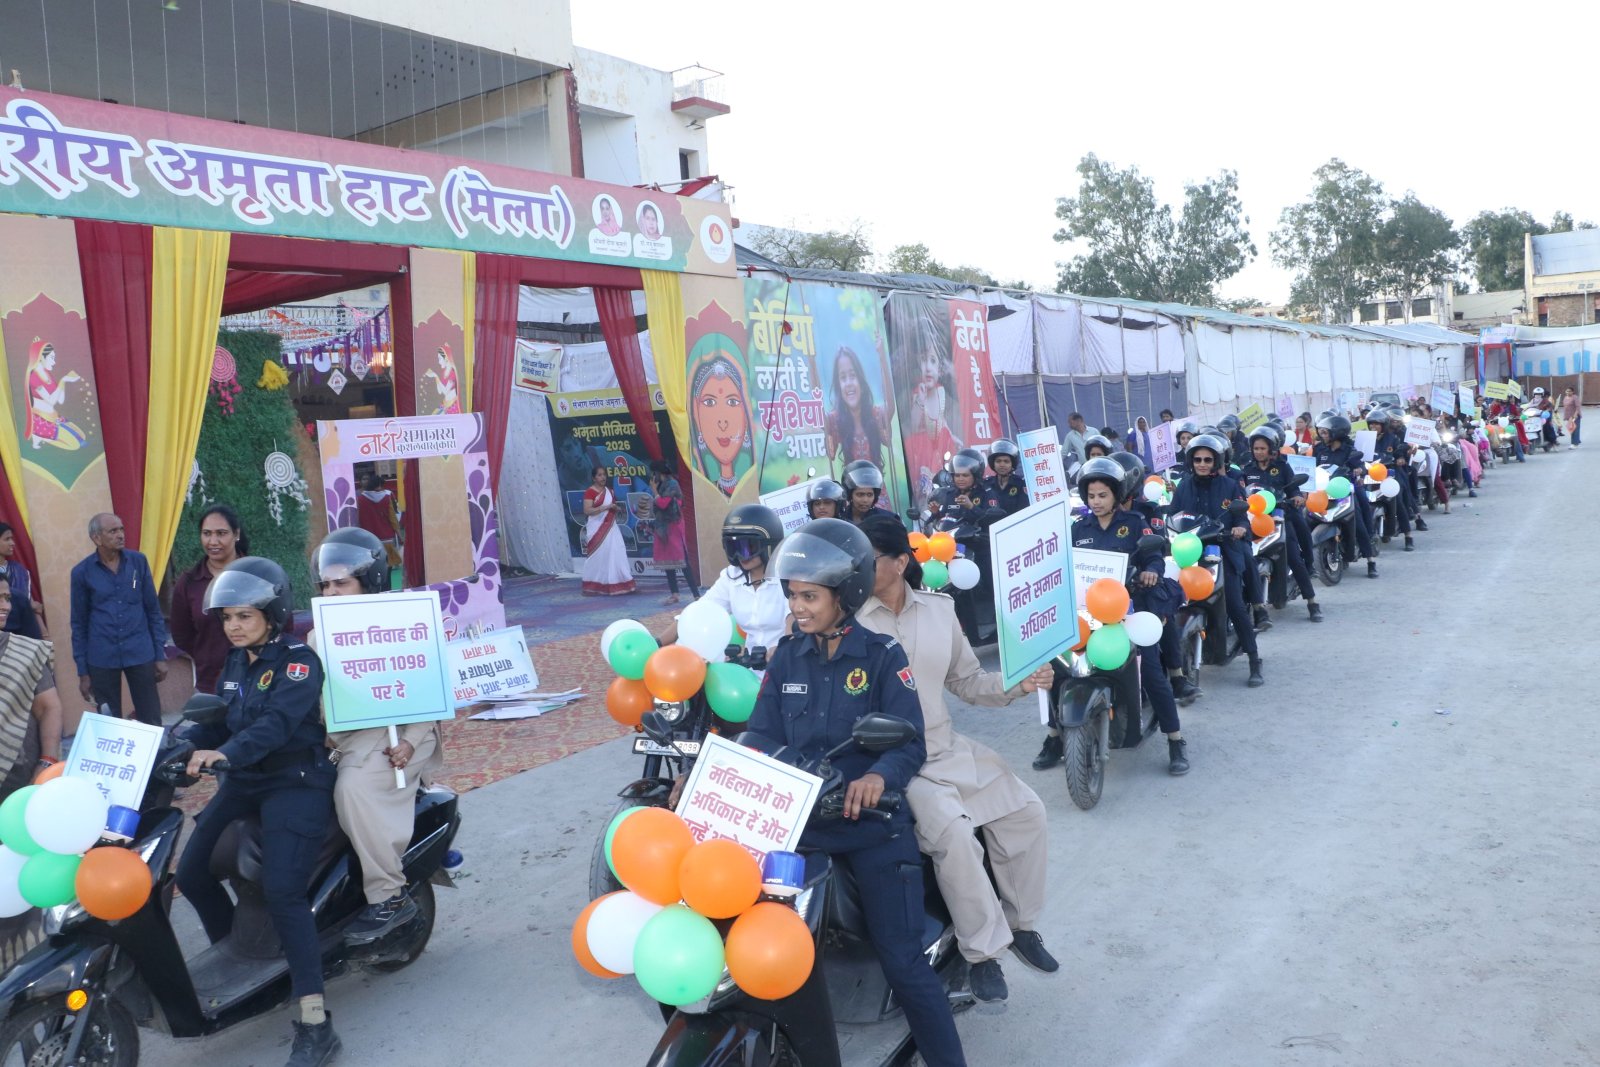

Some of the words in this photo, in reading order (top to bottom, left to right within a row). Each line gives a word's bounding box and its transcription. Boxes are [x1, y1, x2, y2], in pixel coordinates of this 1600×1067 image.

[0, 101, 141, 197] रीय
[147, 141, 336, 223] अमृता
[336, 166, 434, 225] हाट
[441, 168, 575, 248] (मेला)
[749, 298, 815, 355] बेटियां
[954, 309, 986, 352] बेटी
[755, 358, 796, 390] लाती
[798, 357, 810, 392] है
[970, 355, 982, 397] है
[758, 389, 824, 441] खुशियाँ
[972, 404, 992, 438] तो
[572, 425, 600, 442] अमृता
[600, 420, 636, 437] प्रीमियर
[606, 440, 631, 451] 2026
[1024, 448, 1036, 458] बाल
[1038, 444, 1056, 456] विवाह
[606, 466, 646, 476] EASON
[1036, 476, 1054, 486] शिक्षा
[1006, 555, 1022, 578] हर
[1022, 538, 1044, 568] नारी
[1046, 532, 1058, 556] को
[1008, 582, 1032, 613] मिले
[1032, 568, 1062, 598] समान
[332, 631, 364, 646] बाल
[366, 626, 406, 644] विवाह
[408, 622, 428, 641] की
[1020, 605, 1057, 642] अधिकार
[462, 646, 484, 660] जाना
[484, 644, 497, 656] मत
[341, 657, 386, 679] सूचना
[390, 654, 426, 670] 1098
[458, 669, 468, 685] में
[468, 662, 496, 678] विवाह
[495, 659, 514, 672] बाल
[371, 684, 392, 700] पर
[394, 680, 406, 698] दे
[96, 737, 124, 756] नारी
[124, 739, 136, 756] है
[80, 758, 118, 778] समाज
[118, 764, 136, 782] की
[709, 764, 773, 804] महिलाओं
[772, 792, 794, 814] को
[691, 790, 746, 826] अधिकार
[746, 810, 762, 832] दें
[758, 818, 790, 844] और
